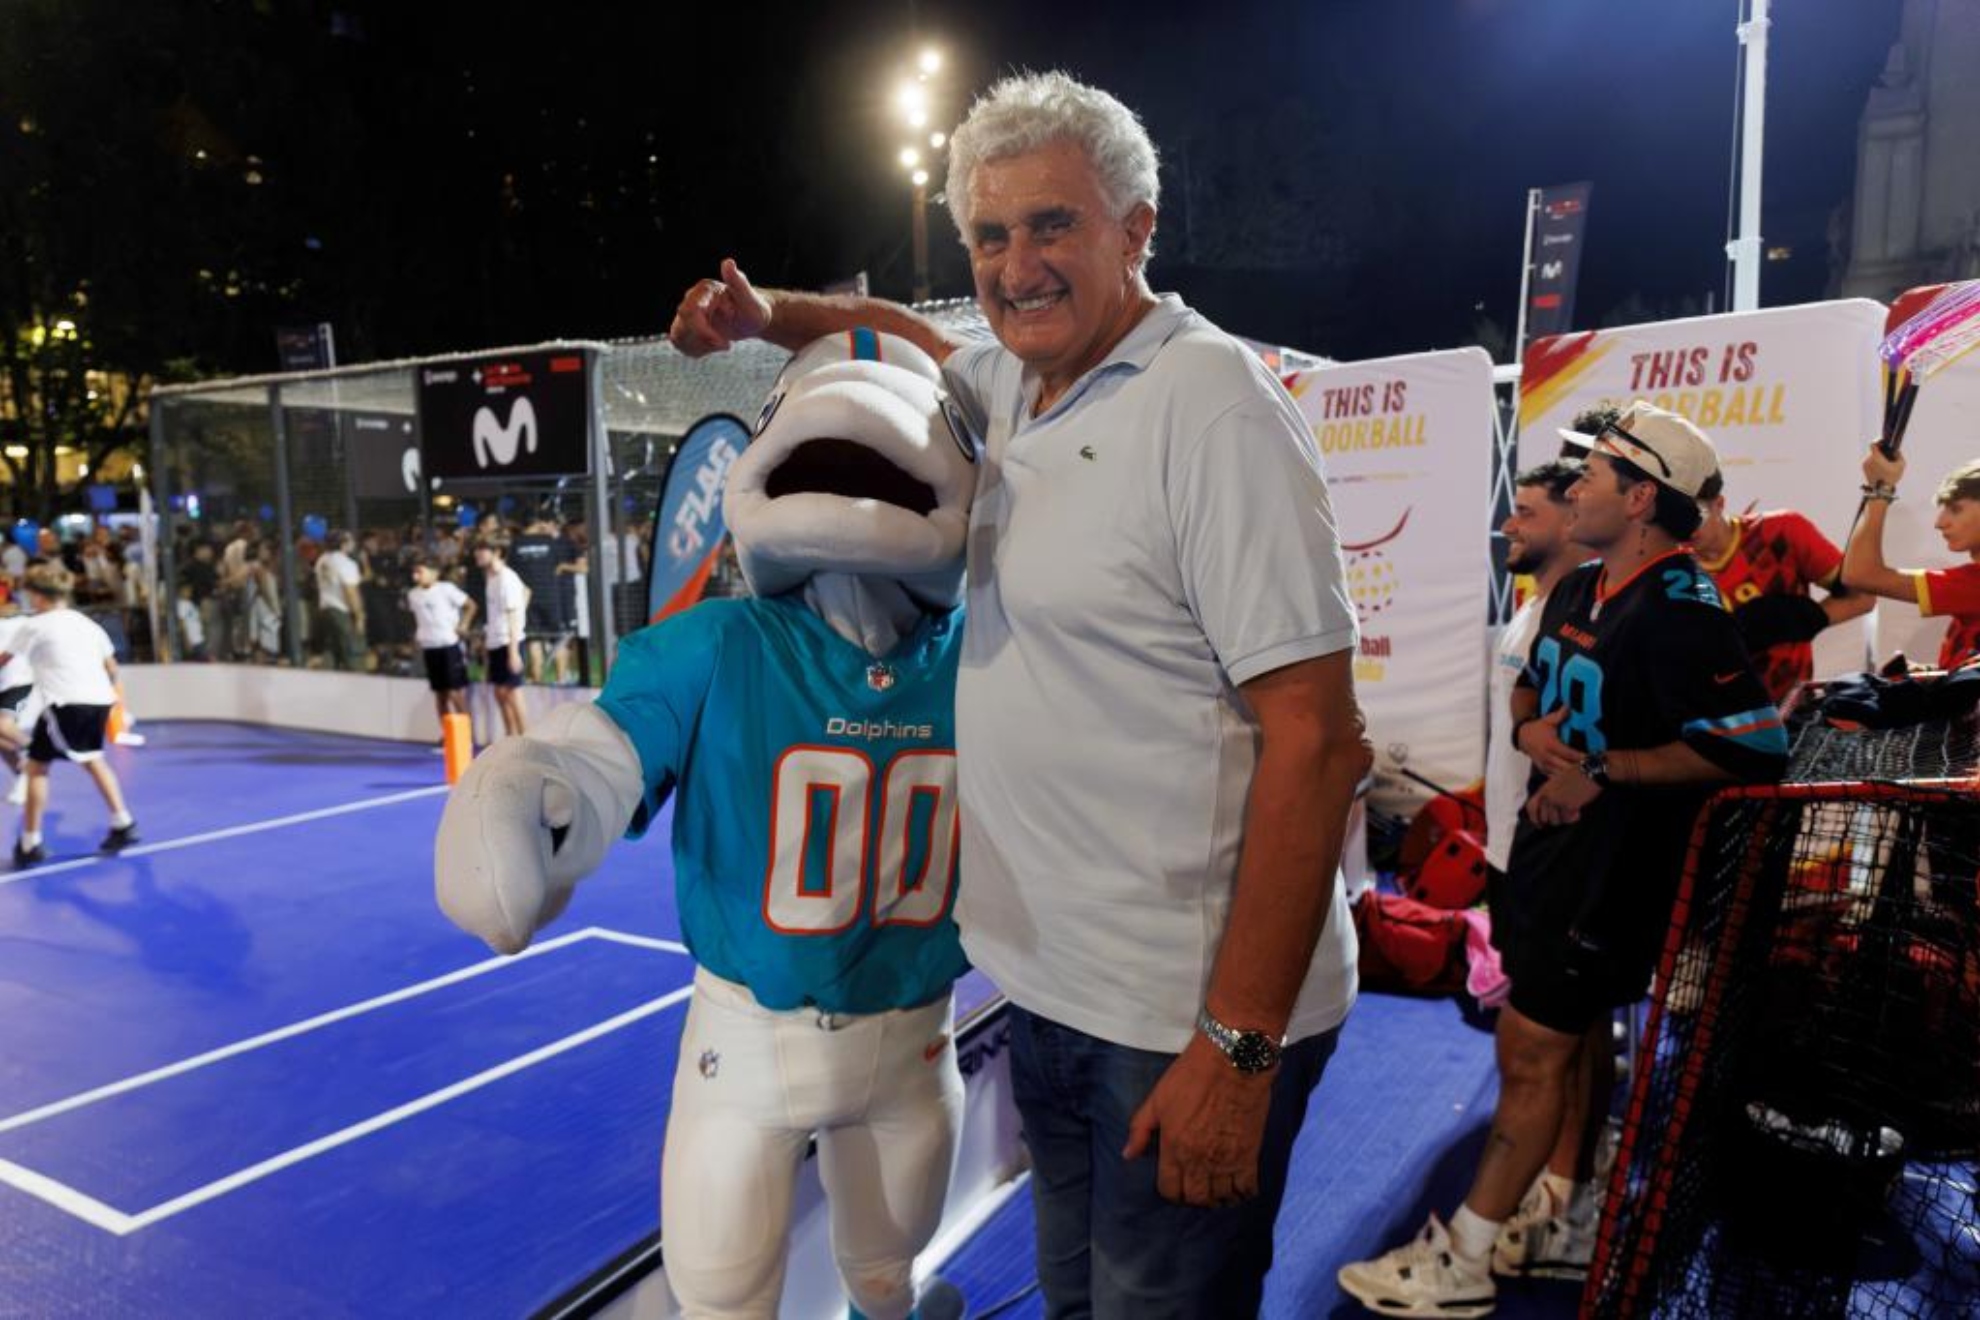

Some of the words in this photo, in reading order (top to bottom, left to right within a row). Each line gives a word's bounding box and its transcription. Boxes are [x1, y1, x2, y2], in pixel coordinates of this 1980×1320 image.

[1630, 346, 1709, 391] THIS
[1718, 341, 1758, 383] IS
[1323, 383, 1375, 419] THIS
[1382, 379, 1407, 414] IS
[826, 716, 933, 741] Dolphins
[763, 743, 960, 935] 00
